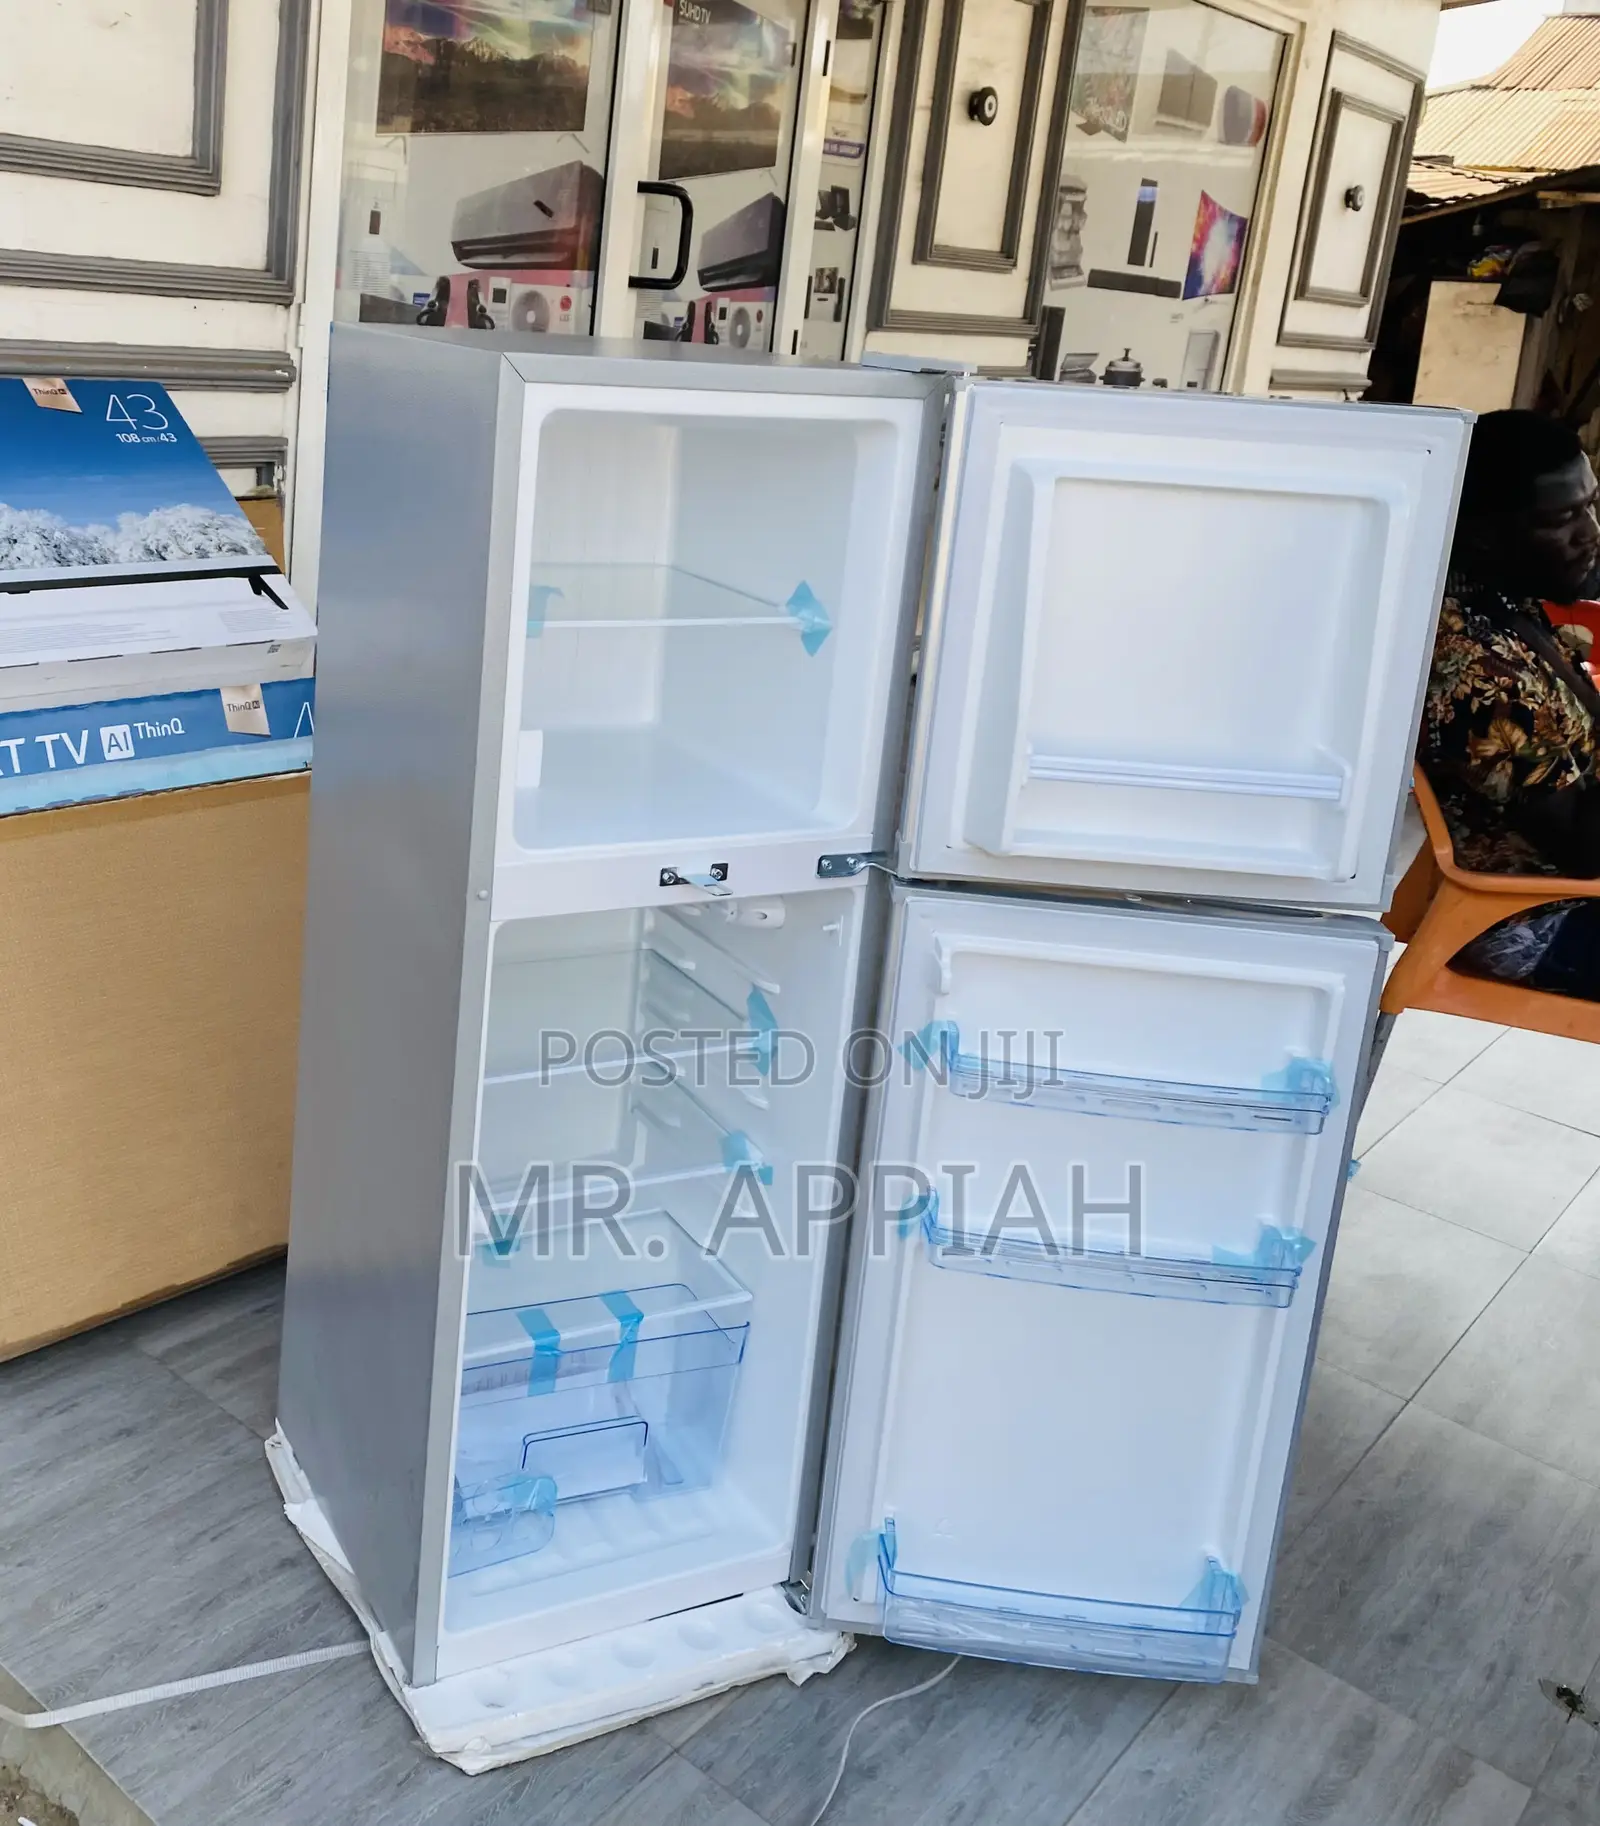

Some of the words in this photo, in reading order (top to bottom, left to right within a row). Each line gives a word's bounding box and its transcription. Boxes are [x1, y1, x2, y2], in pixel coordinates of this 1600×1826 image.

[106, 394, 169, 430] 43
[116, 432, 141, 443] 108
[226, 701, 252, 713] ThinQ
[0, 737, 25, 775] T
[34, 729, 89, 768] TV
[133, 717, 185, 740] ThinQ
